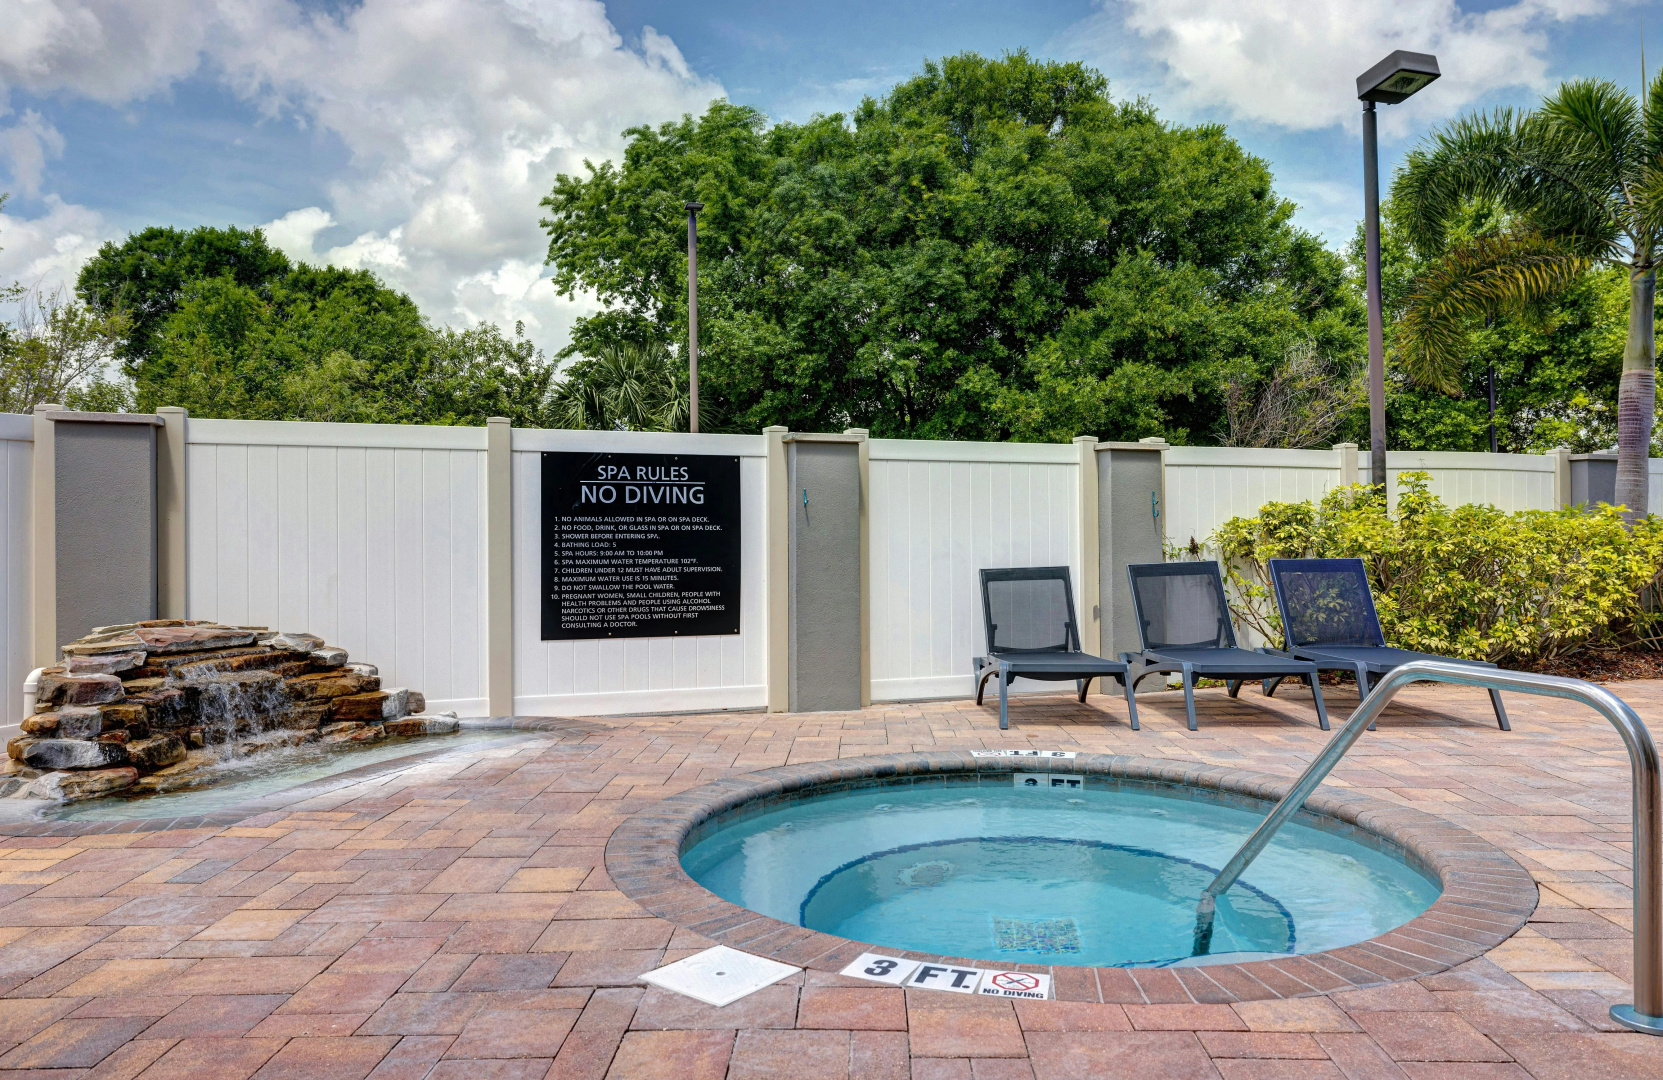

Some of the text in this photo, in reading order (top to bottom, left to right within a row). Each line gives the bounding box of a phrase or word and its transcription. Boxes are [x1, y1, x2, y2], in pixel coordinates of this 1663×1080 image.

[597, 465, 688, 480] SPA RULES
[581, 485, 705, 504] NO DIVING
[864, 960, 977, 989] 3 FT.
[1004, 990, 1044, 998] DIVING
